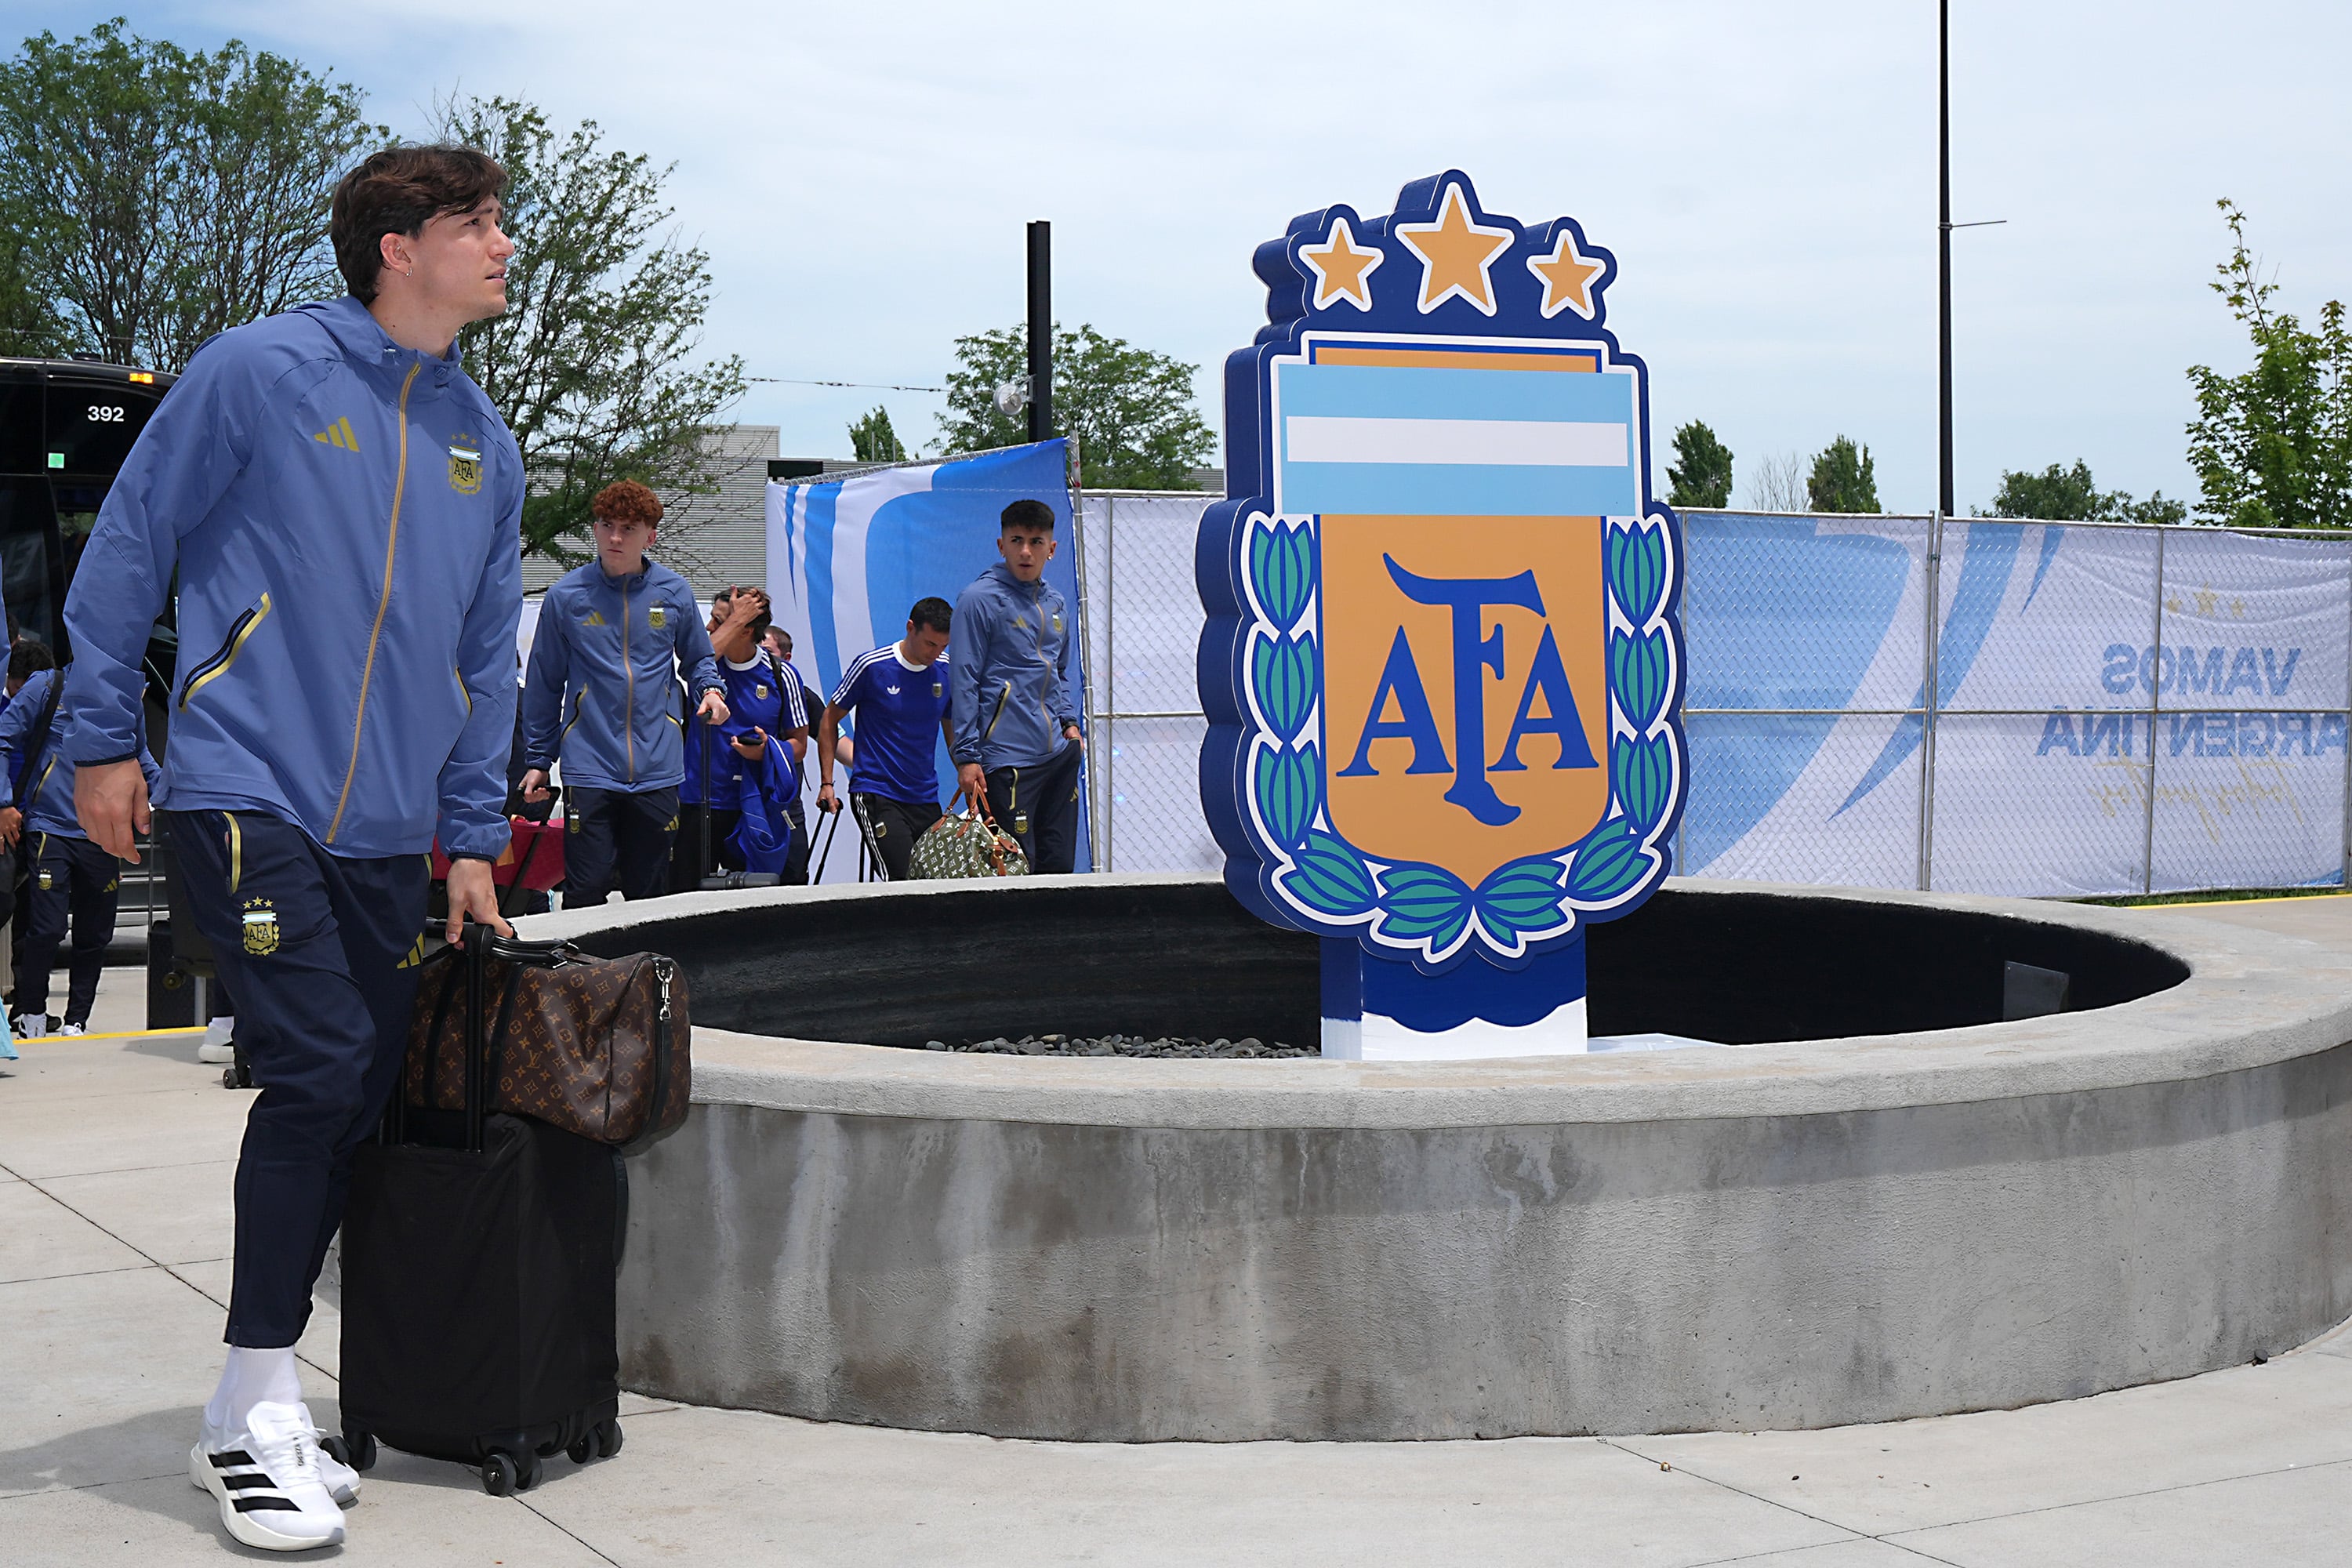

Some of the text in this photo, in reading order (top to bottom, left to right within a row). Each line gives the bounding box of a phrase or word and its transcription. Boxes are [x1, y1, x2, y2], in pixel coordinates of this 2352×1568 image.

[87, 405, 125, 422] 392
[453, 457, 475, 481] AFA
[1336, 552, 1599, 827] AFA
[249, 922, 270, 943] AFA
